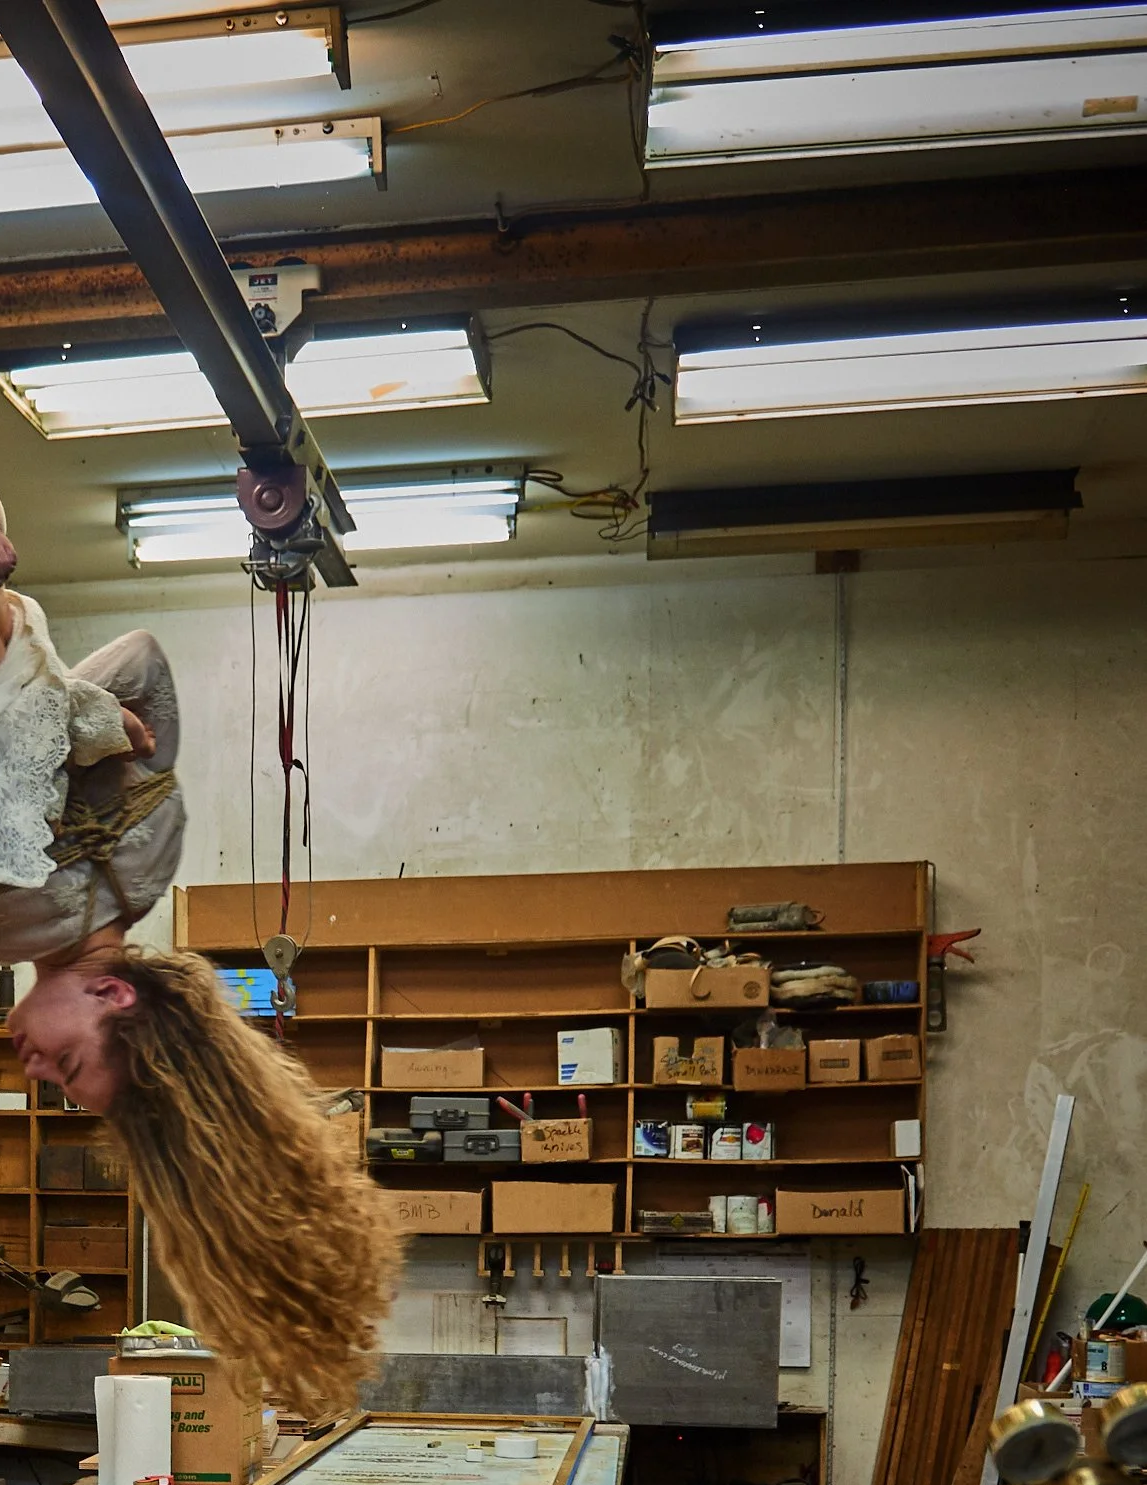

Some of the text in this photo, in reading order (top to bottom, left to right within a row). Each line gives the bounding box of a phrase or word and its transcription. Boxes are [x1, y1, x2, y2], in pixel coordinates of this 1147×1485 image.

[544, 1125, 582, 1143] Spackle
[812, 1199, 865, 1219] Donald
[1101, 1361, 1107, 1371] B
[172, 1377, 201, 1386] AUL
[1075, 1385, 1081, 1398] A
[184, 1410, 205, 1420] and
[178, 1423, 211, 1432] Boxes
